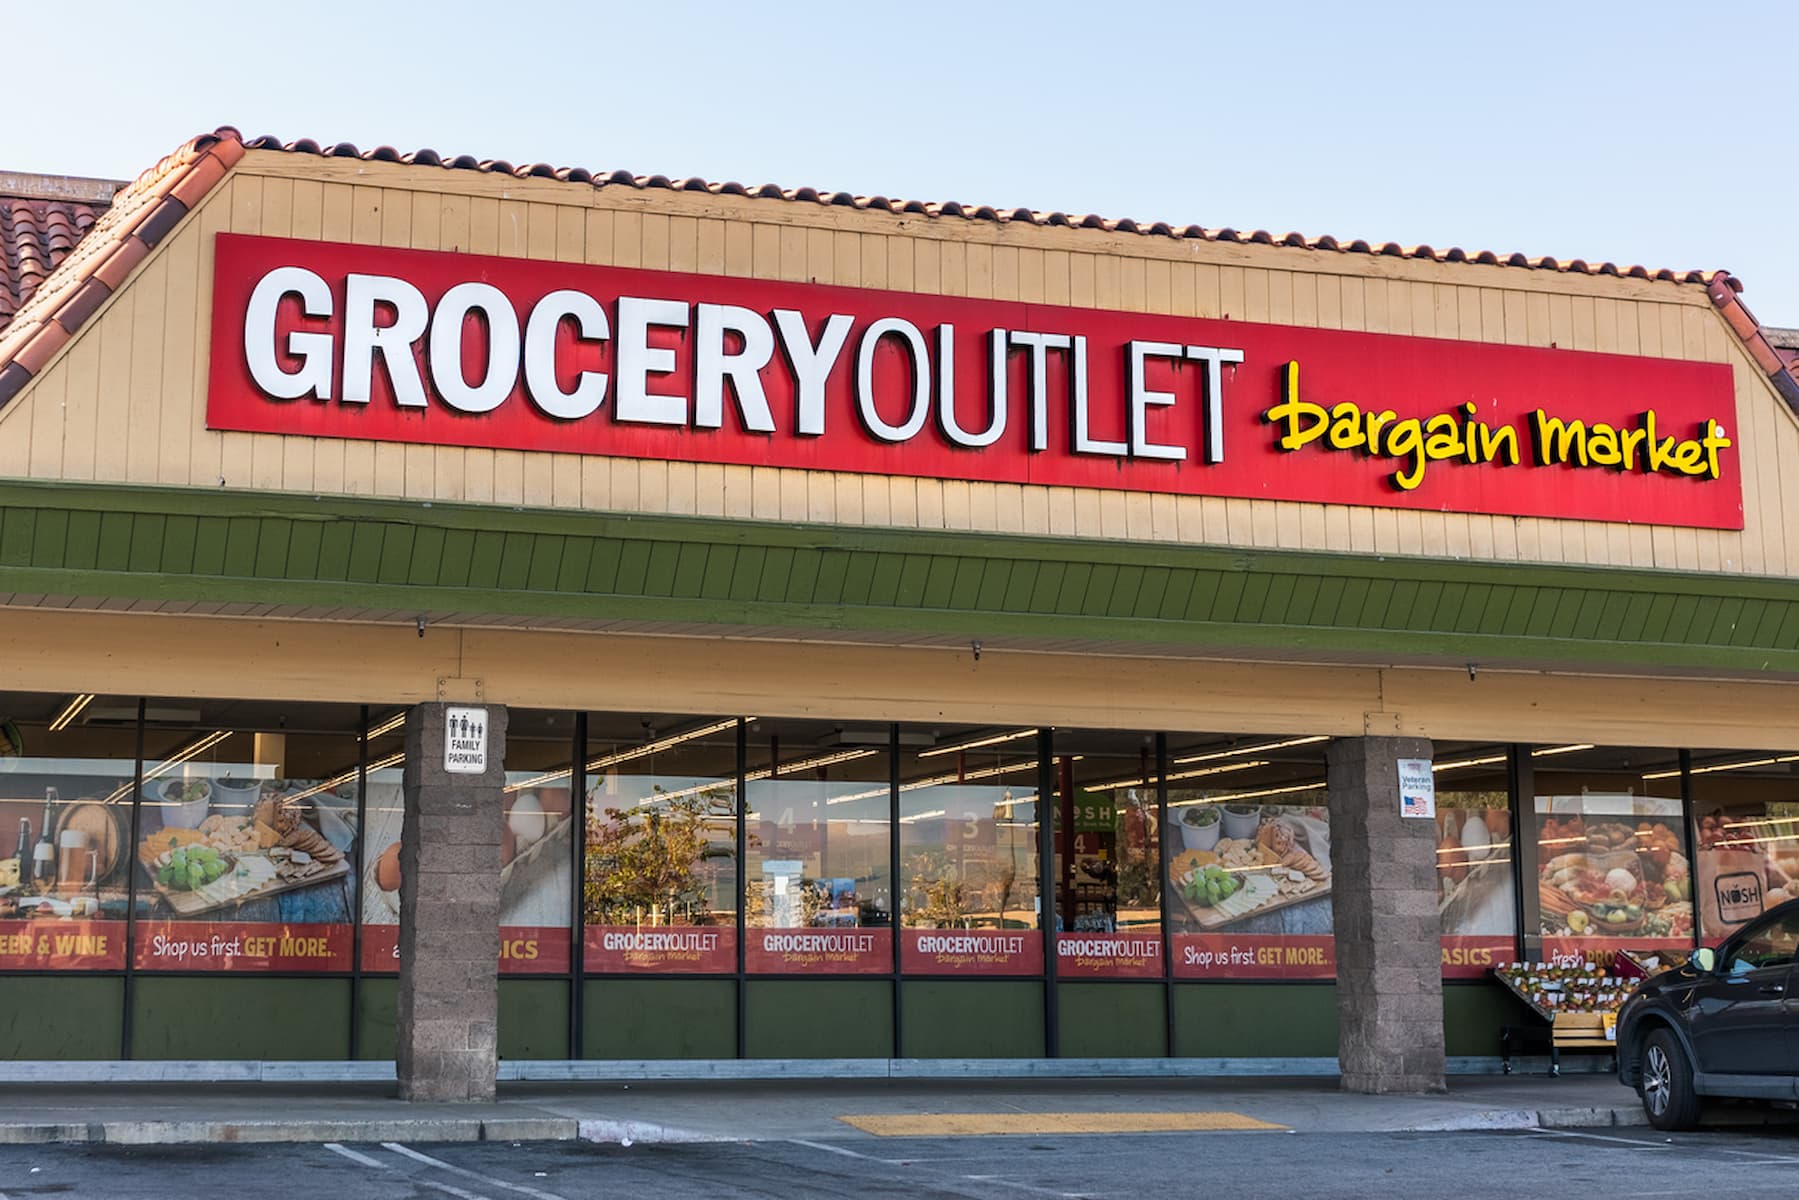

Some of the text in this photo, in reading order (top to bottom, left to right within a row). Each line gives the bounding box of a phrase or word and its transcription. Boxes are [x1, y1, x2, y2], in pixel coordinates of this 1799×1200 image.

[1266, 360, 1731, 490] bargain market
[451, 739, 480, 750] FAMILY
[448, 752, 483, 765] PARKING
[1402, 775, 1431, 783] Veteran
[1402, 782, 1431, 793] Parking
[963, 811, 978, 839] 3
[1074, 834, 1086, 853] 4
[37, 935, 50, 955] &
[55, 936, 108, 956] WINE
[152, 935, 188, 961] Shop
[191, 942, 207, 956] us
[211, 935, 241, 956] first.
[244, 937, 277, 957] GET
[498, 940, 538, 959] ICS
[1184, 946, 1213, 969] Shop
[1215, 952, 1228, 965] us
[1231, 946, 1256, 965] first.
[1257, 947, 1283, 965] GET
[1552, 948, 1584, 967] fresh
